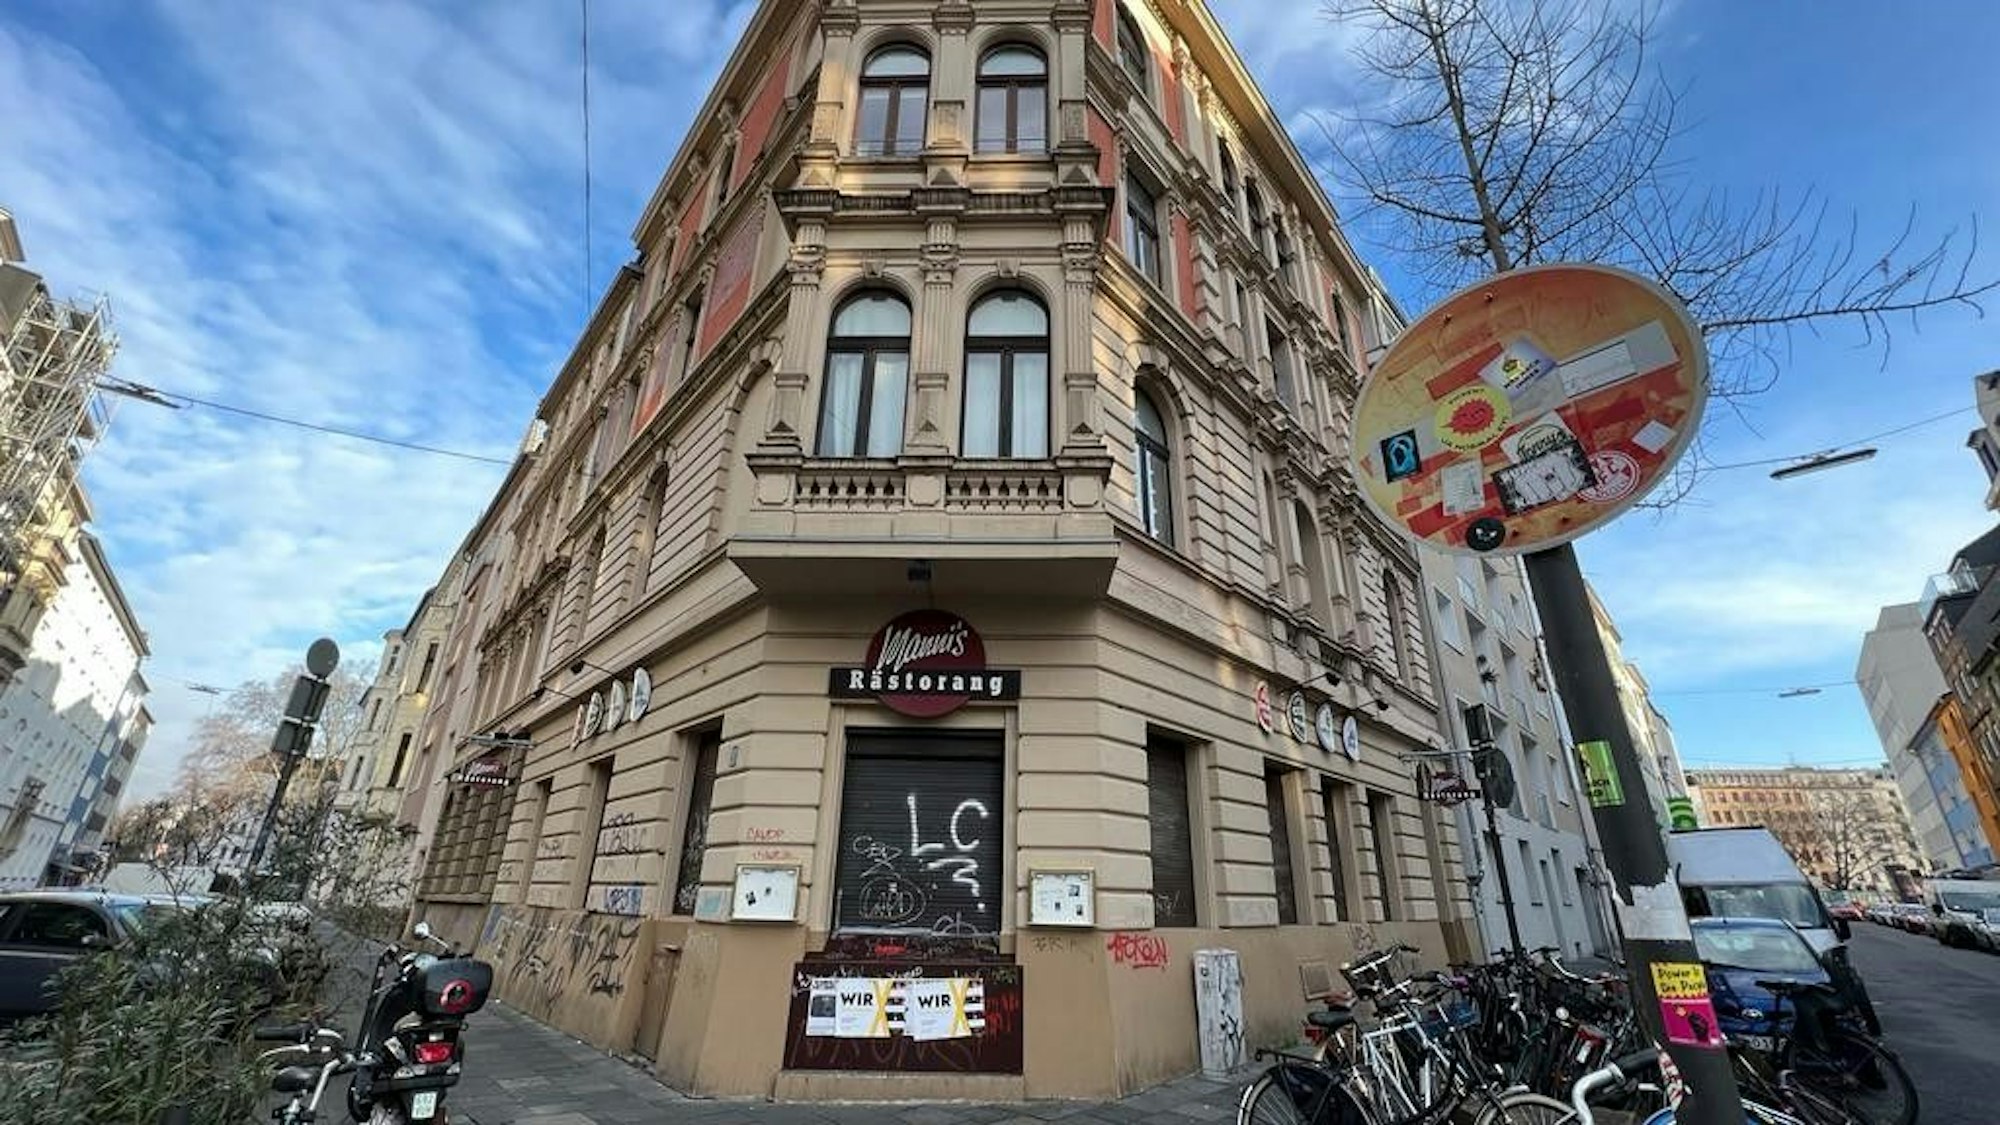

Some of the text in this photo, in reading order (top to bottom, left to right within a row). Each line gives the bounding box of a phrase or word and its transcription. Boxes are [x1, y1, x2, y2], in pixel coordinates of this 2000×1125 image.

[849, 670, 1003, 697] Rästorang
[841, 993, 873, 1006] WIR
[918, 994, 950, 1008] WIR
